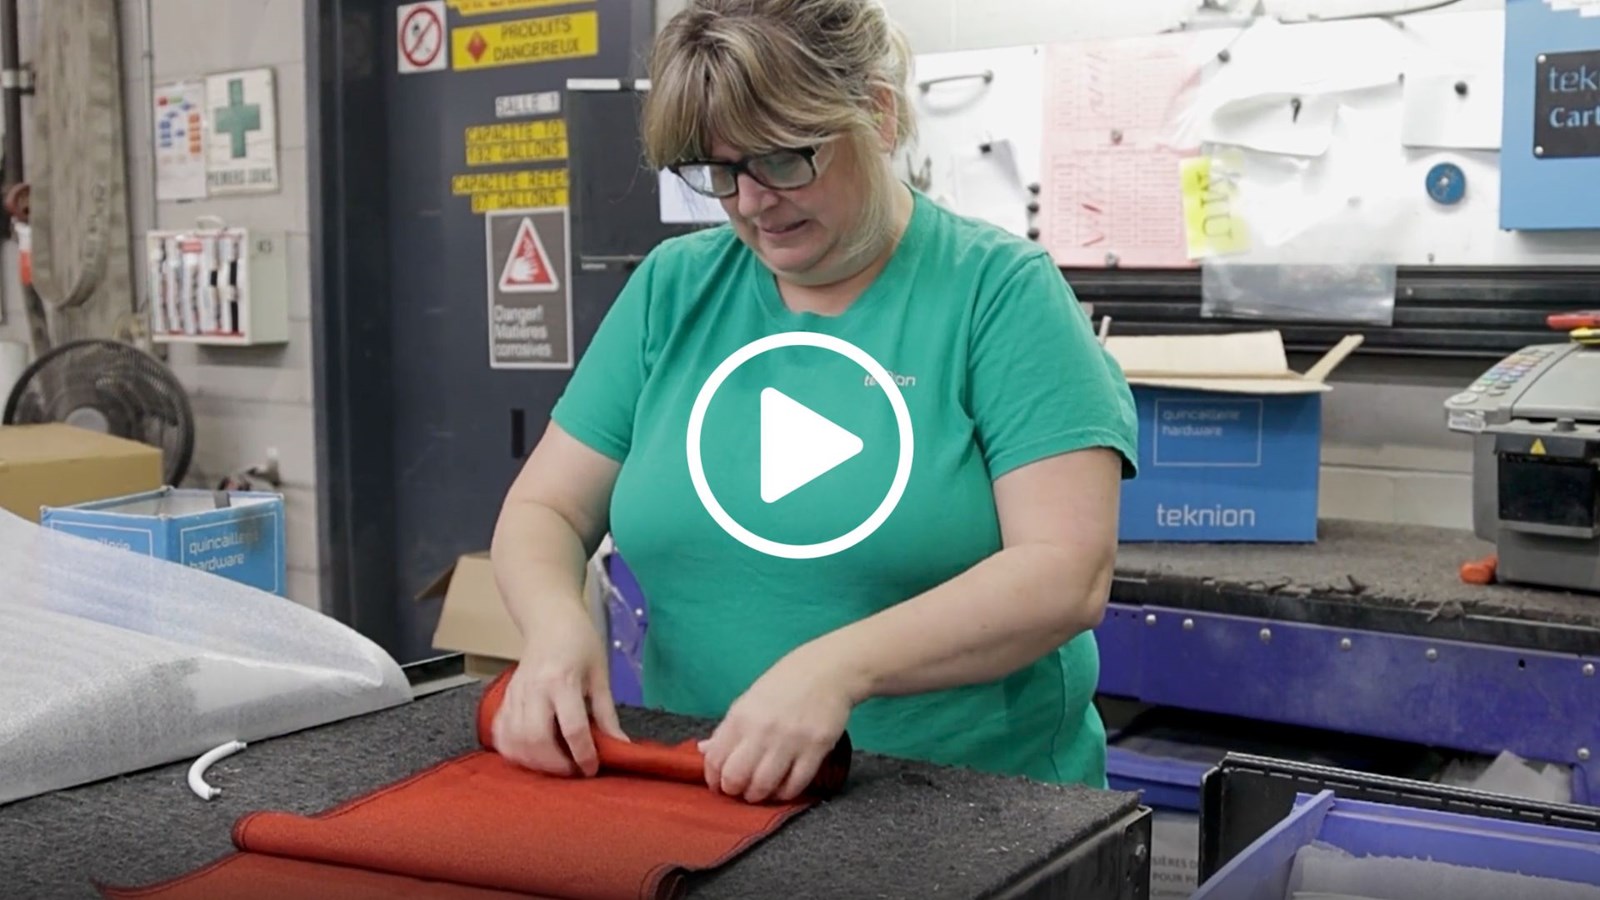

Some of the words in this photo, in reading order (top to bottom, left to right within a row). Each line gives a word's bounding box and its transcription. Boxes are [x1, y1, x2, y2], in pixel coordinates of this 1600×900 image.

[501, 17, 572, 40] PRODUITS
[493, 38, 580, 62] DANGEREUX
[1549, 65, 1600, 92] tek
[497, 94, 539, 114] SALLE
[502, 139, 559, 159] GALLONS
[498, 189, 557, 208] GALLONS
[494, 305, 543, 325] Danger!
[494, 343, 552, 357] corrosives
[1161, 424, 1223, 436] hardware
[1156, 504, 1255, 526] teknion
